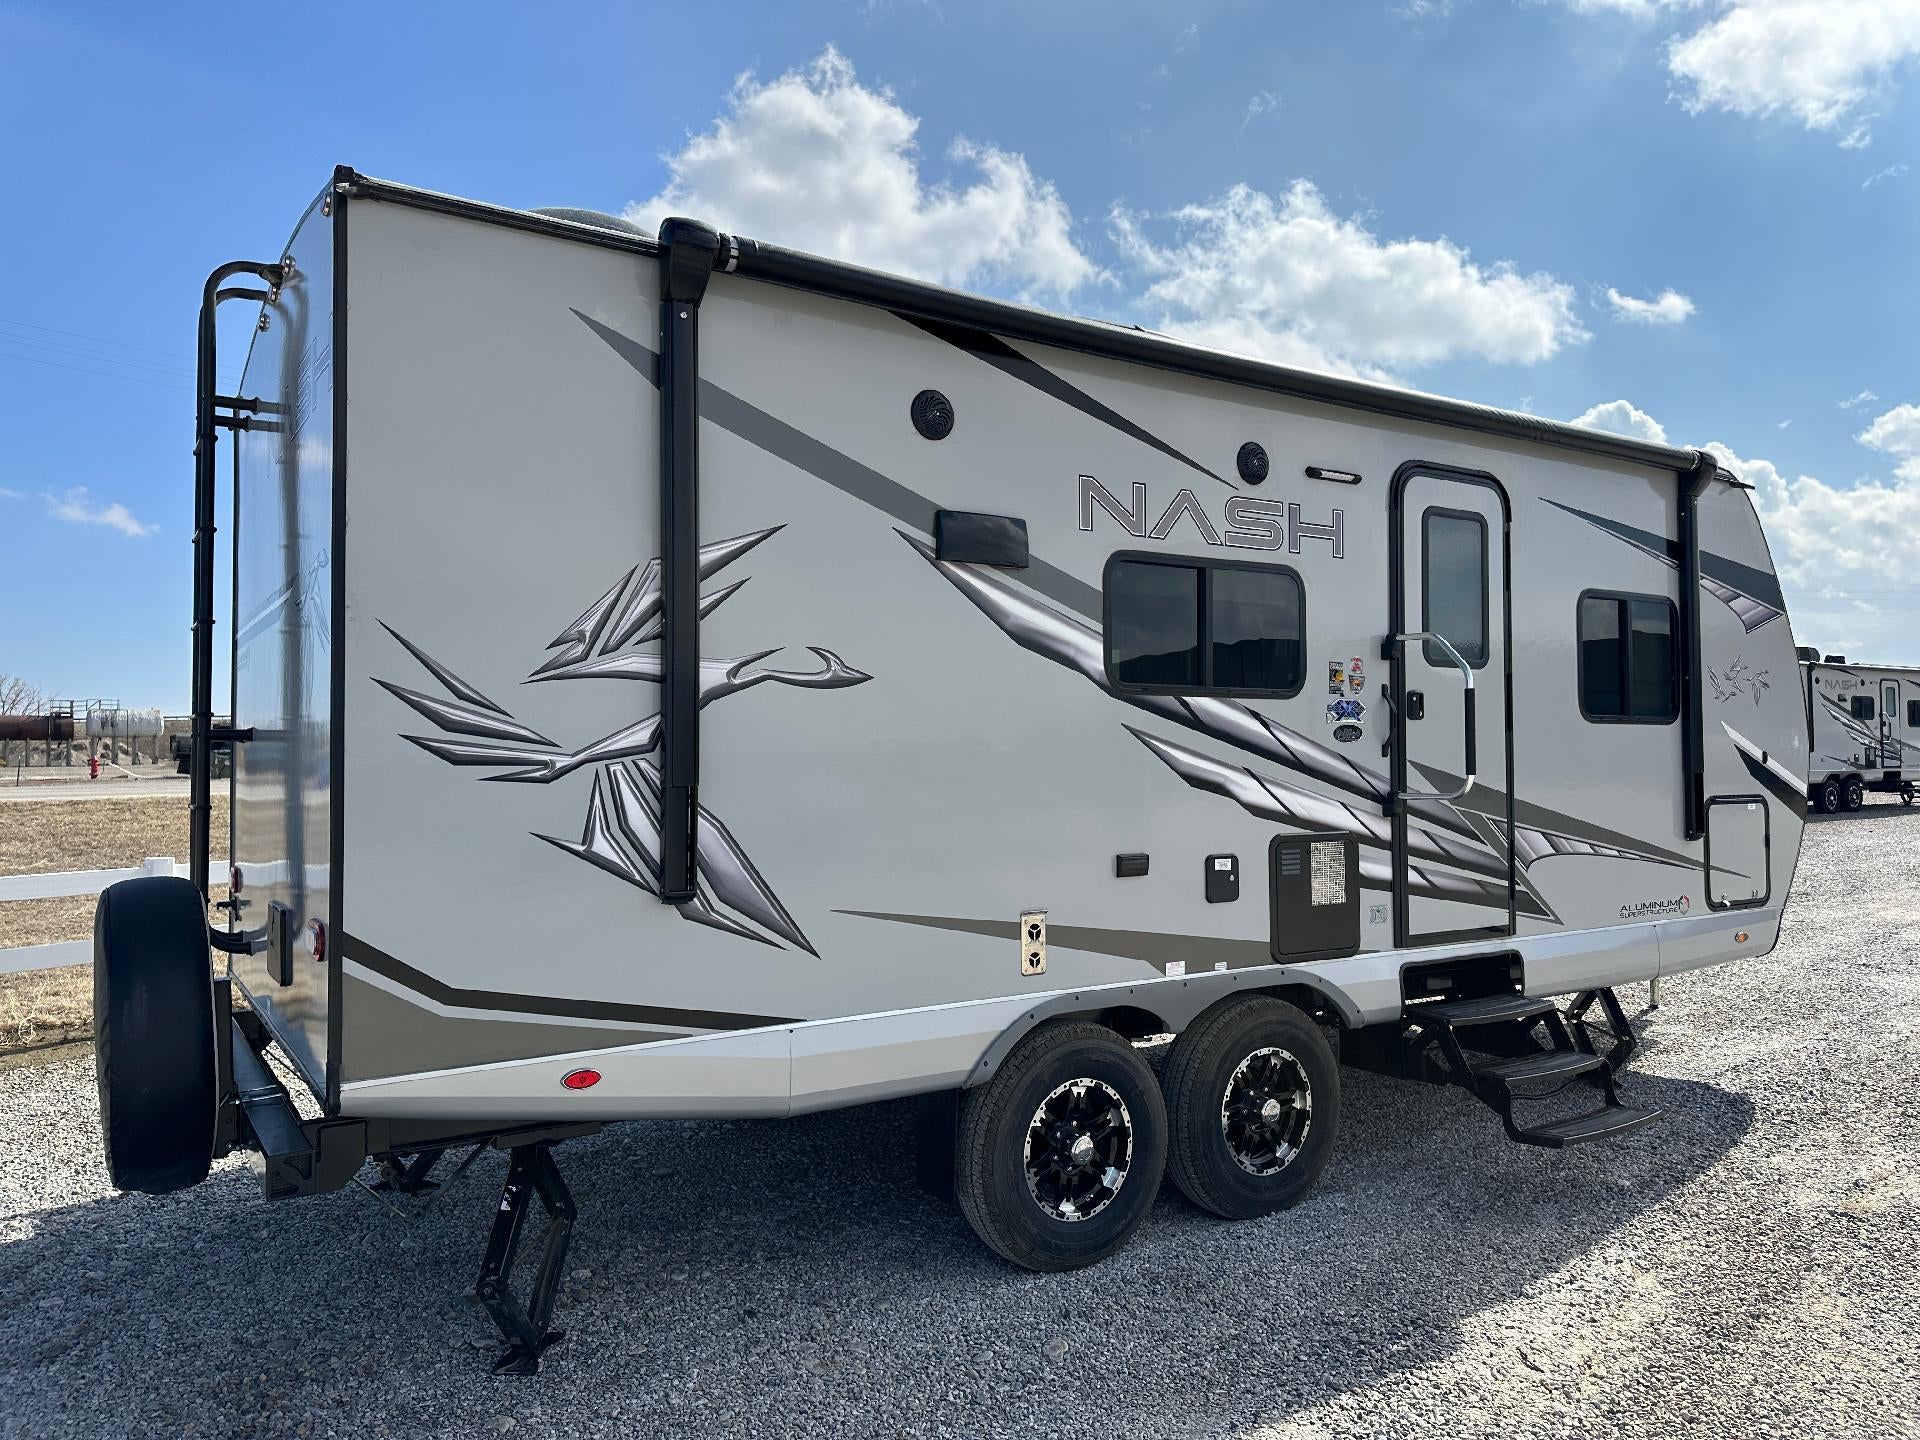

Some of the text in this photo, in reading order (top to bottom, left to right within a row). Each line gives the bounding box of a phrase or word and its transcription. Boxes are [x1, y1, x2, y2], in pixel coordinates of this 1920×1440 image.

[1078, 473, 1345, 560] NASH
[1824, 678, 1858, 691] NASH
[1619, 899, 1679, 913] ALUMINUM
[1619, 906, 1679, 919] SUPERSTRUCTURE
